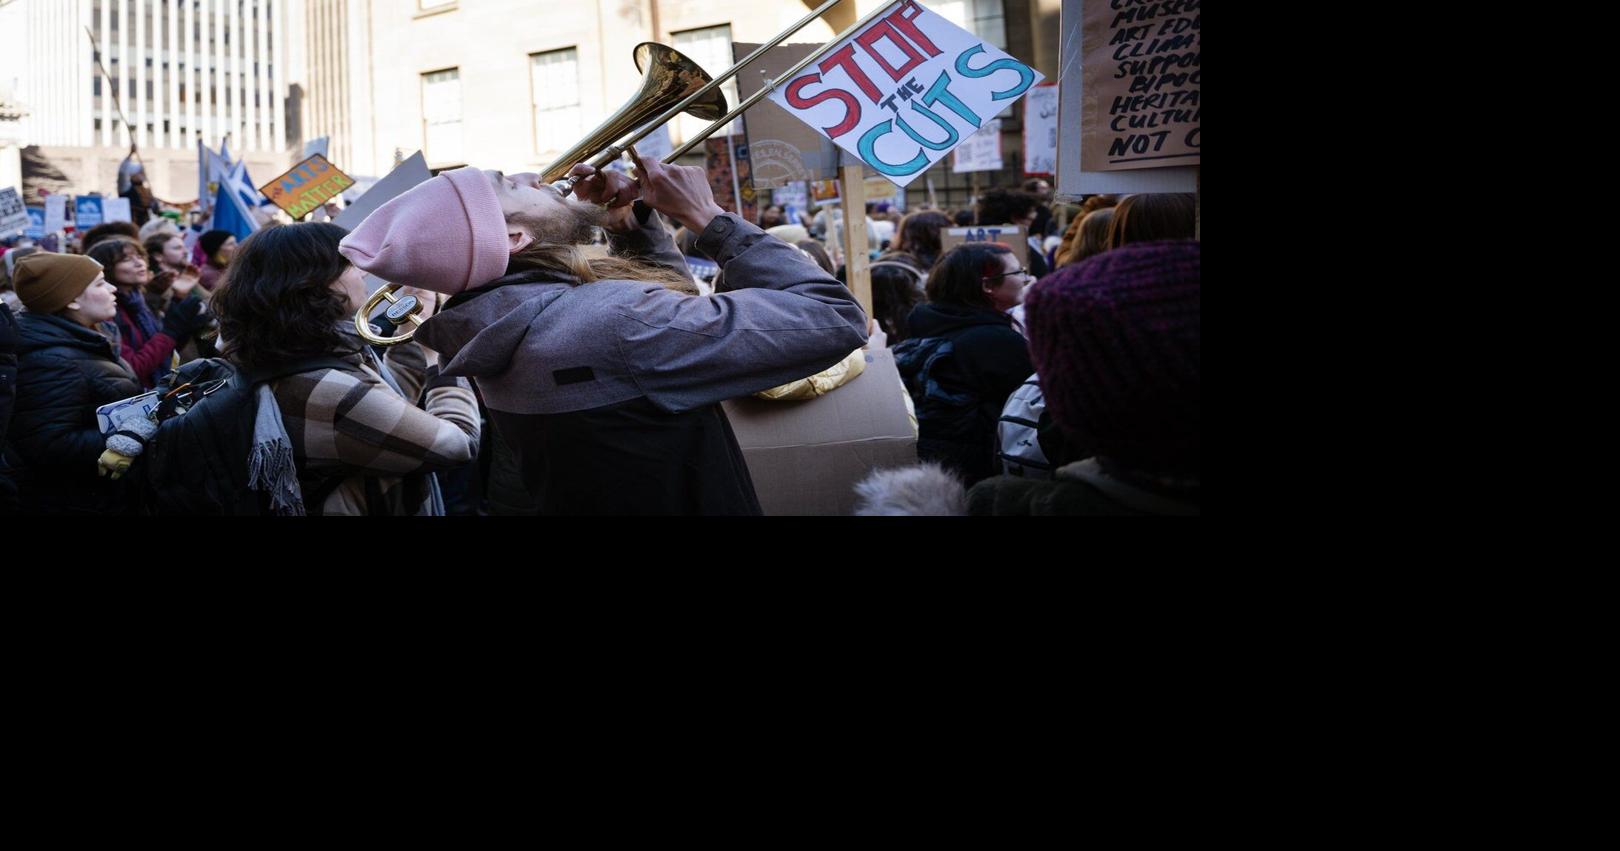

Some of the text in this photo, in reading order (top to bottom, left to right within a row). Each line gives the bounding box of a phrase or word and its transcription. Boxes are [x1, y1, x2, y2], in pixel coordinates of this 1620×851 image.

[1109, 23, 1155, 45] ART
[1113, 33, 1200, 60] CLIMA
[785, 1, 943, 140] STOP
[857, 43, 1036, 177] CUTS
[880, 76, 924, 113] THE
[1108, 131, 1171, 156] NOT
[287, 175, 350, 219] MATTER
[965, 227, 1002, 242] ART
